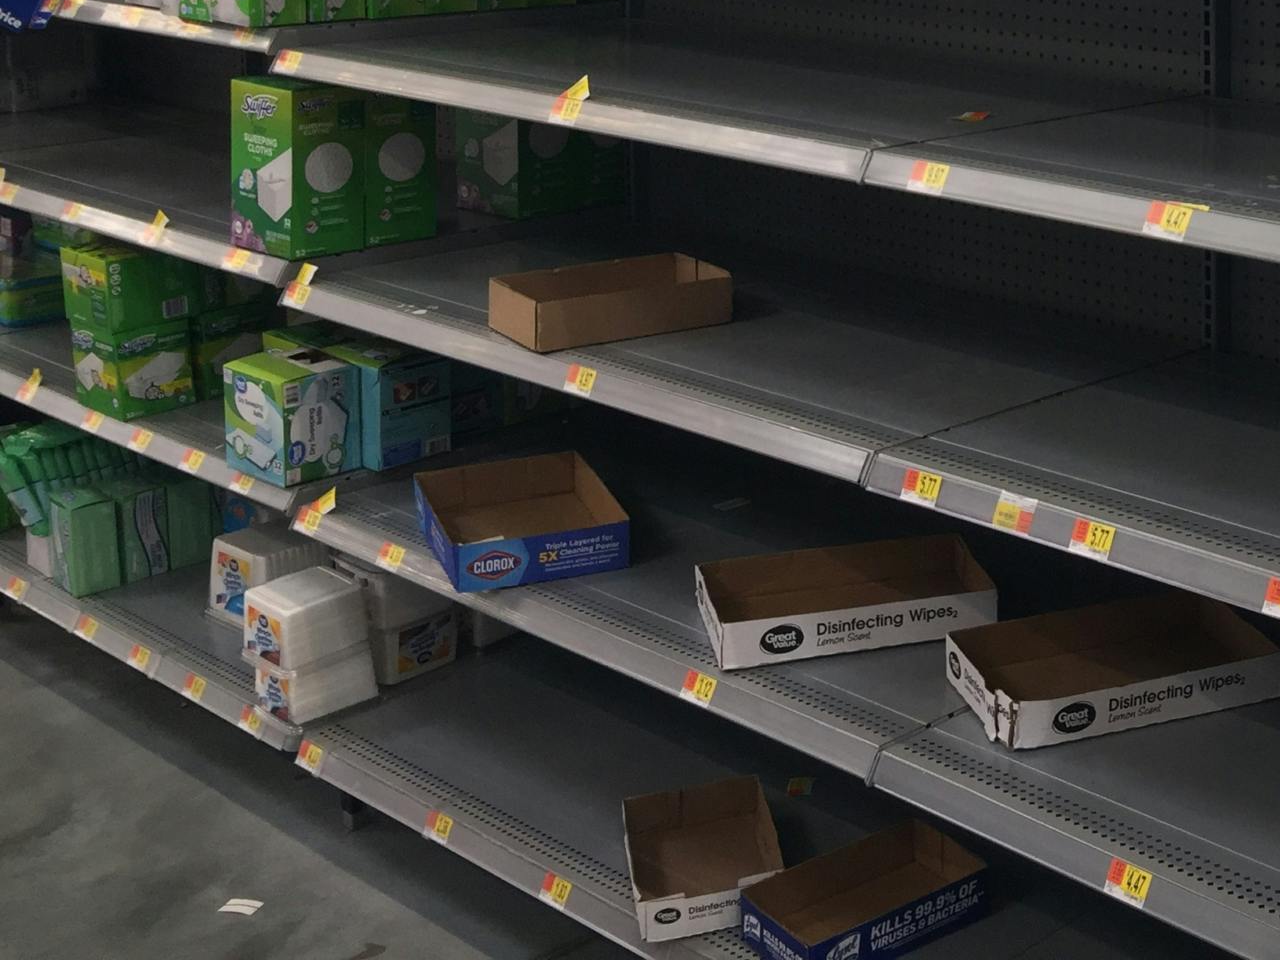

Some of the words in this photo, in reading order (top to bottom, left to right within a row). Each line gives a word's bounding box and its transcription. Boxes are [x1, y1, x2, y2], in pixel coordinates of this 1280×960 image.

[0, 7, 22, 29] rice
[546, 540, 567, 552] Triple
[568, 537, 600, 550] Layered
[560, 544, 594, 556] Cleaning
[539, 551, 558, 564] 5X
[473, 557, 515, 574] CLOROX
[817, 613, 904, 636] Disinfecting
[765, 631, 797, 643] Great
[773, 639, 798, 649] Value
[1108, 683, 1194, 712] Disinfecting
[1058, 709, 1090, 722] Great
[1107, 710, 1137, 724] Lemon
[870, 907, 913, 940] KILLS
[915, 888, 957, 920] 99.9%
[959, 879, 979, 899] OF
[870, 924, 917, 951] VIRUSES
